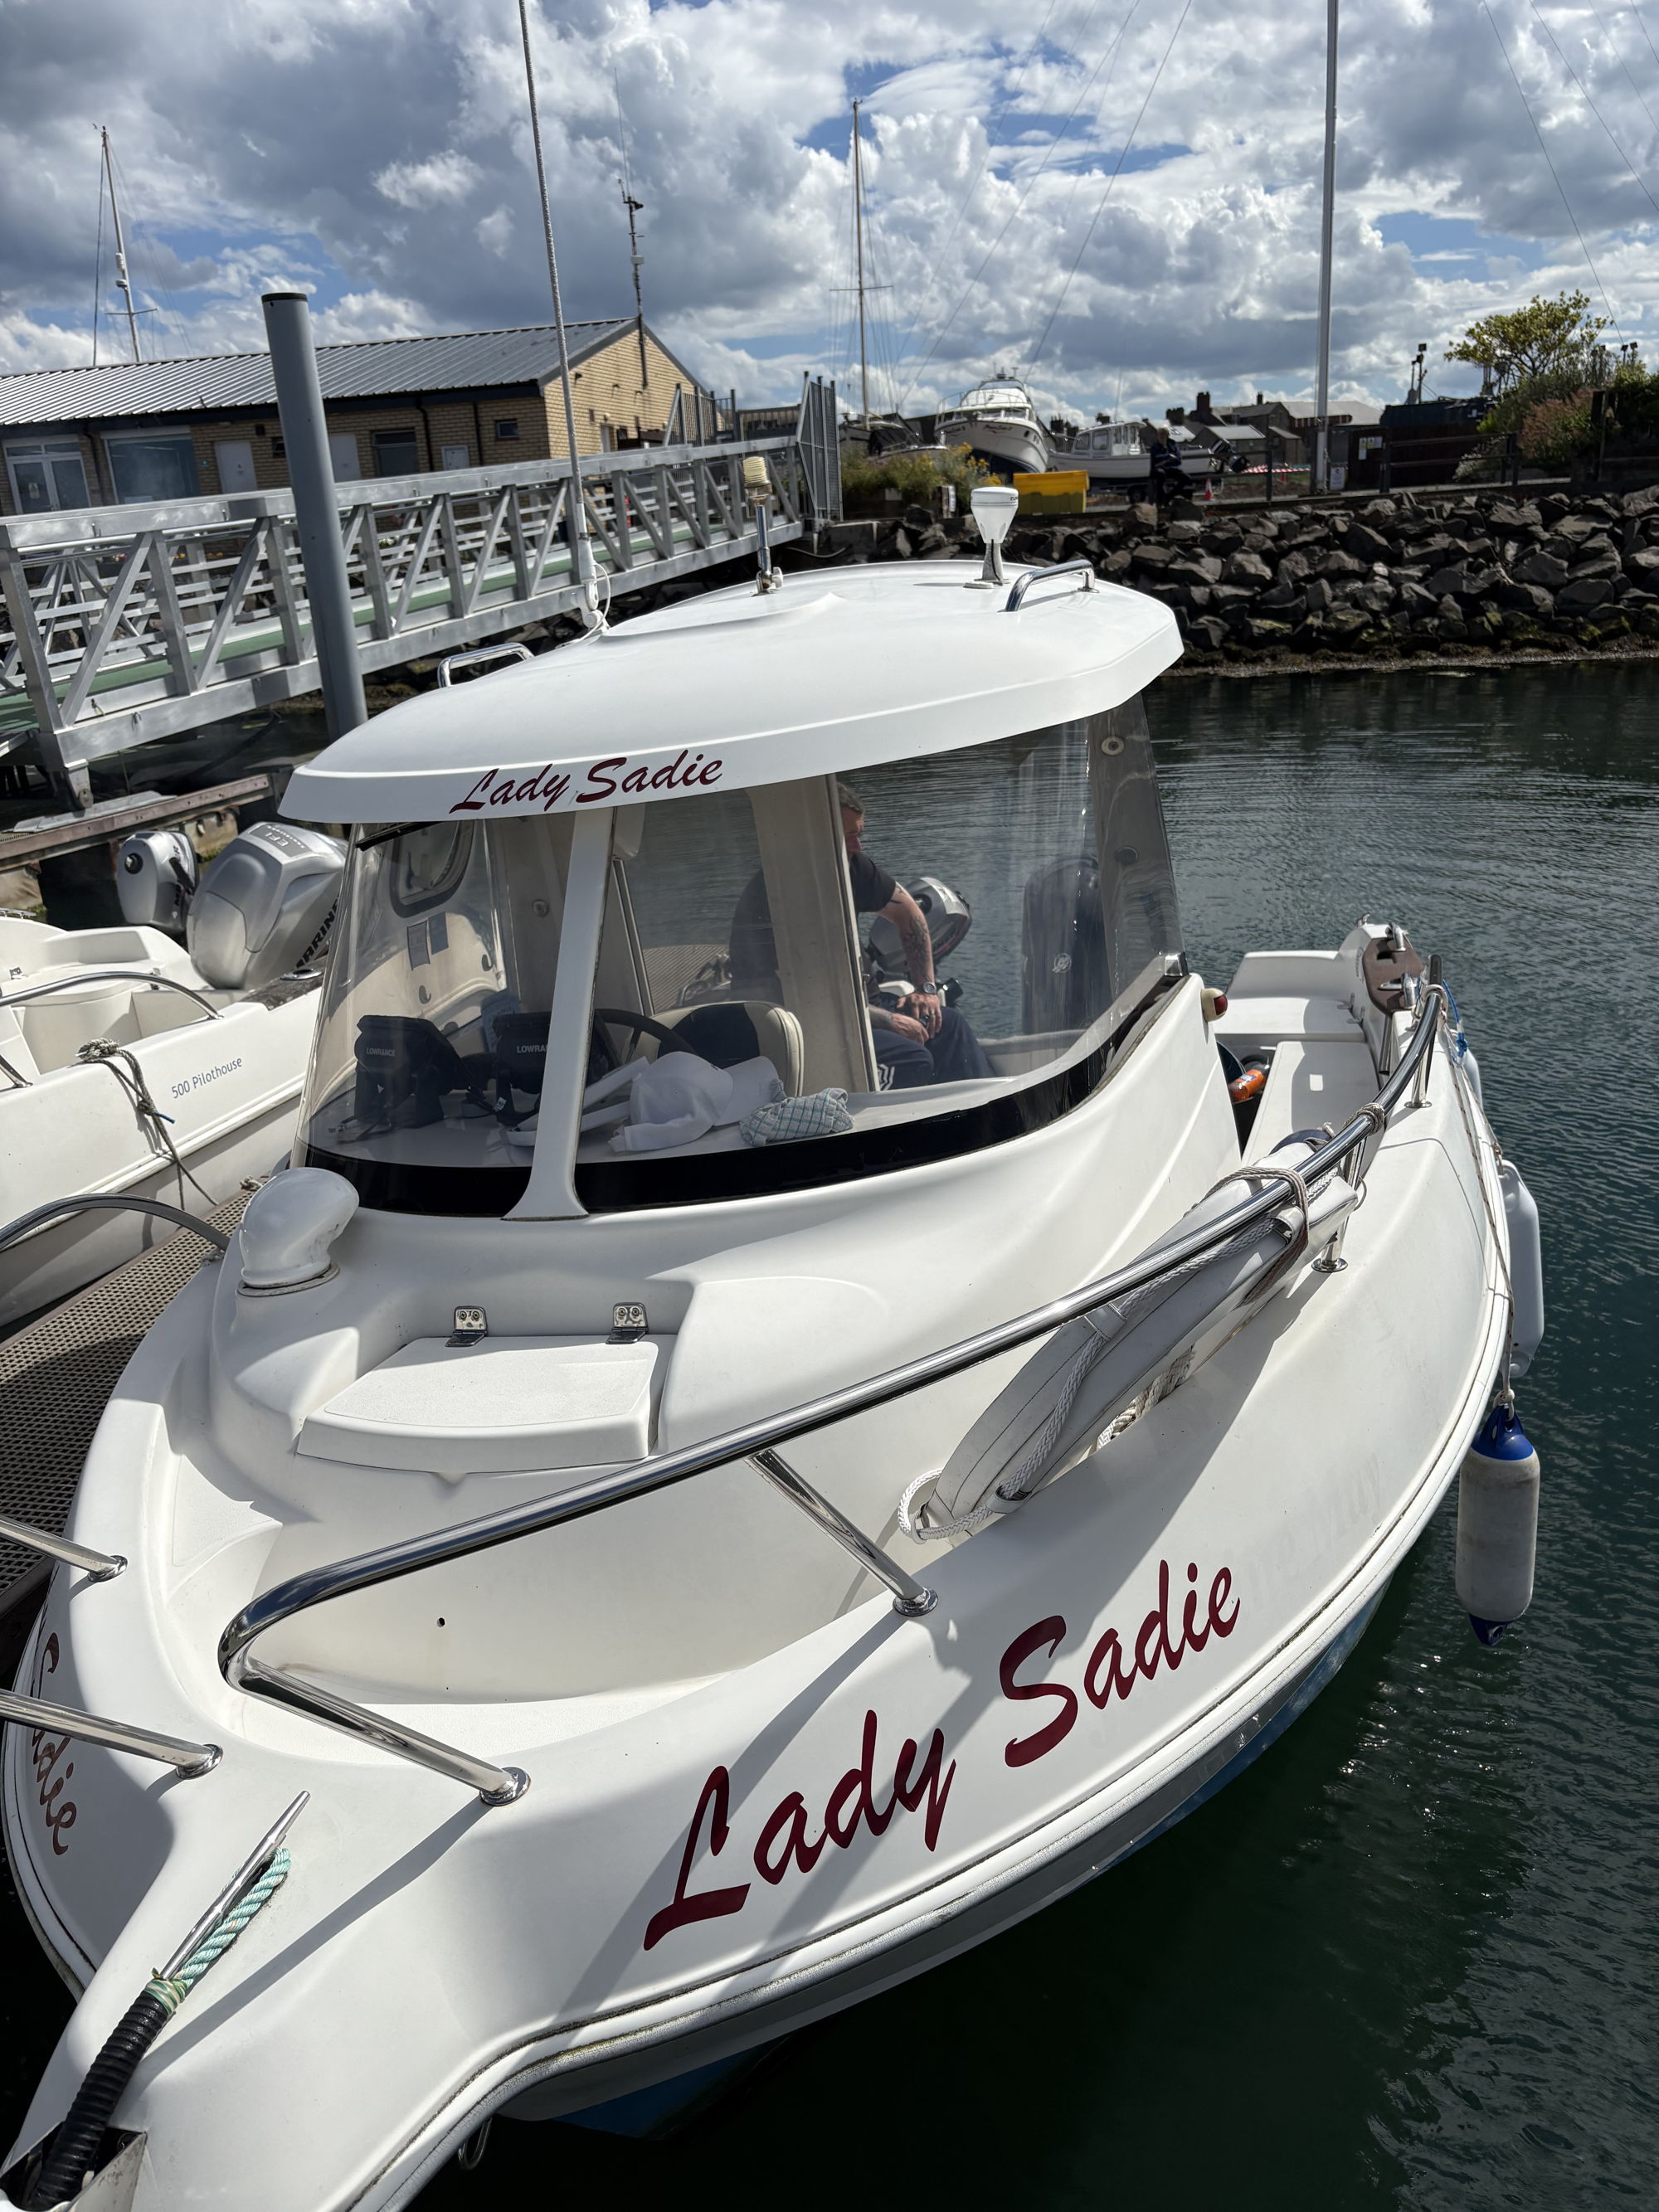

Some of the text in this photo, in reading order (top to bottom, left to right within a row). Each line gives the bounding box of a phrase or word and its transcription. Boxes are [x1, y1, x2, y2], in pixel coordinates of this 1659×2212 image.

[449, 749, 723, 814] Lady Sadie
[366, 1048, 396, 1057] LOWRANCE
[517, 1043, 548, 1054] LOWRA
[171, 1057, 242, 1099] 500 Pilothouse
[643, 1559, 1241, 1951] Lady Sadie
